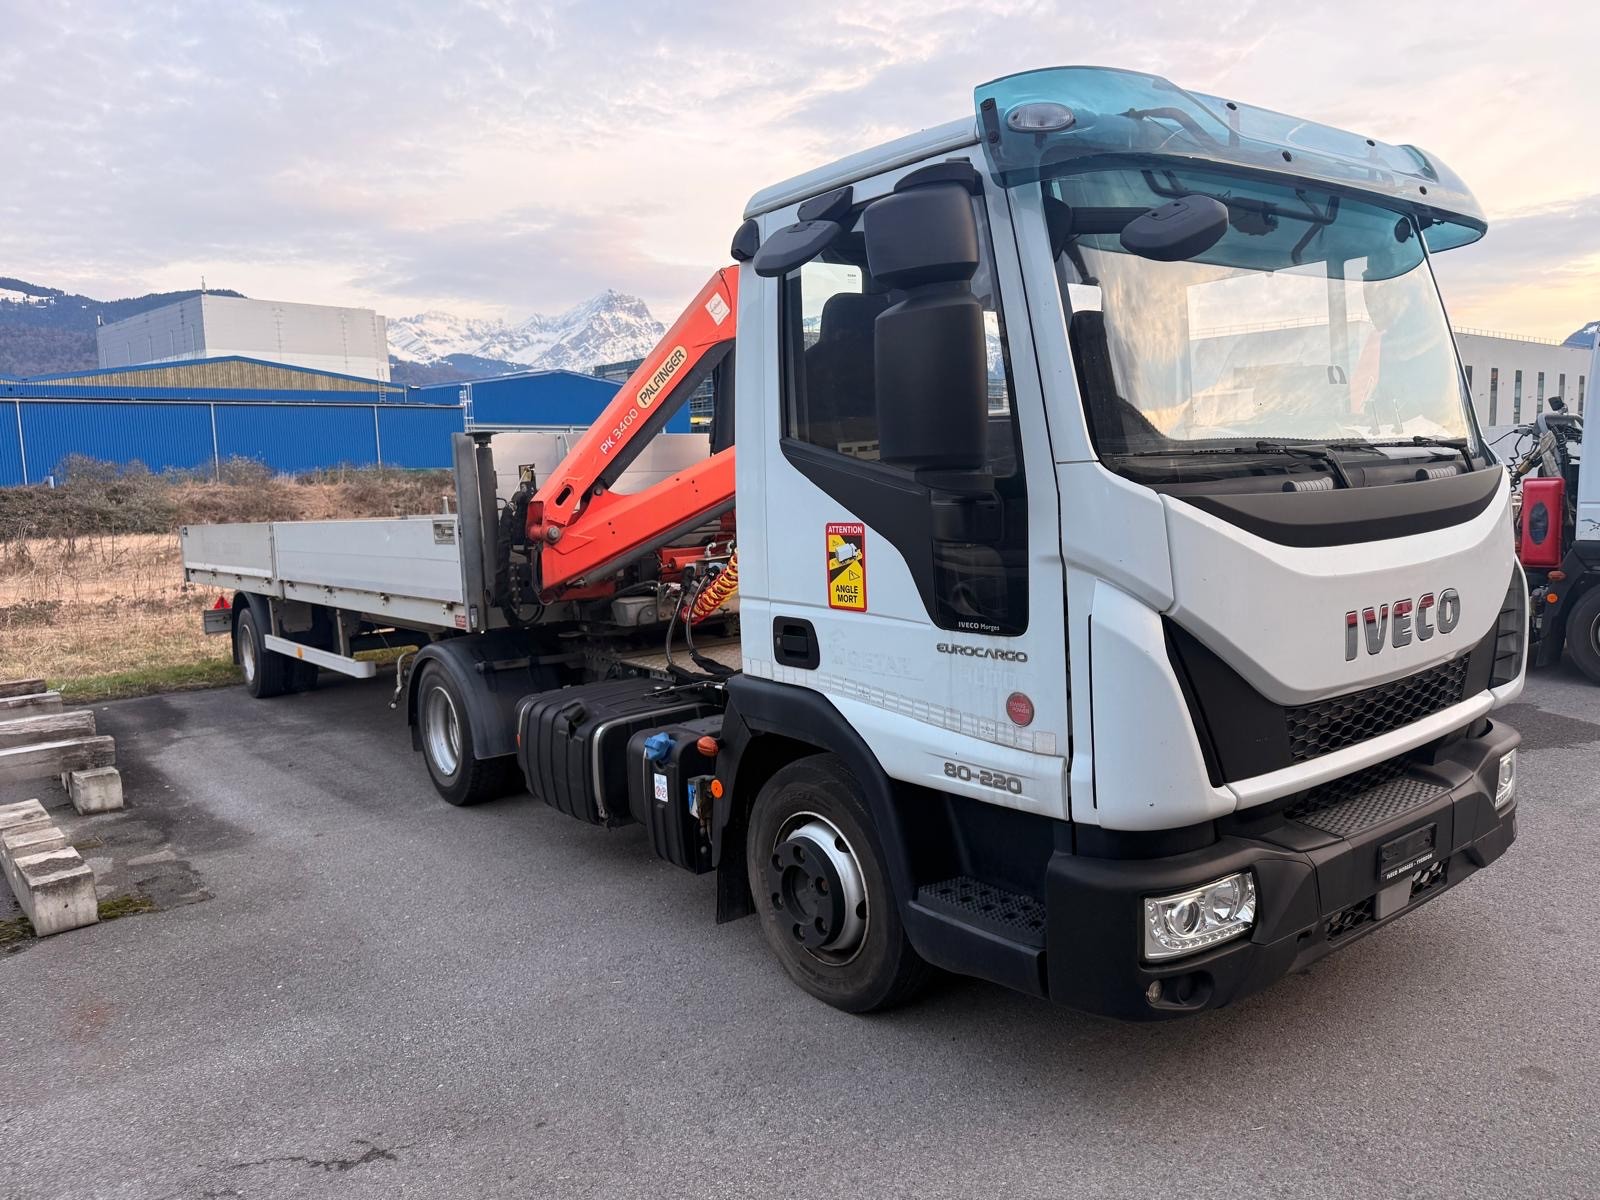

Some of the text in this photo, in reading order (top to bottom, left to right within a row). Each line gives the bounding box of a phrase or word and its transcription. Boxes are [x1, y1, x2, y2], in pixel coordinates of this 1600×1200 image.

[639, 349, 685, 406] PALFINGER
[600, 436, 616, 454] PK
[828, 525, 863, 534] ATTENTION
[835, 584, 859, 595] ANGLE
[837, 594, 858, 603] MORT
[958, 621, 1001, 632] IVECO Morges
[1344, 587, 1461, 662] IVECO
[936, 643, 1028, 663] EUROCARGO
[943, 762, 1023, 795] 80-220
